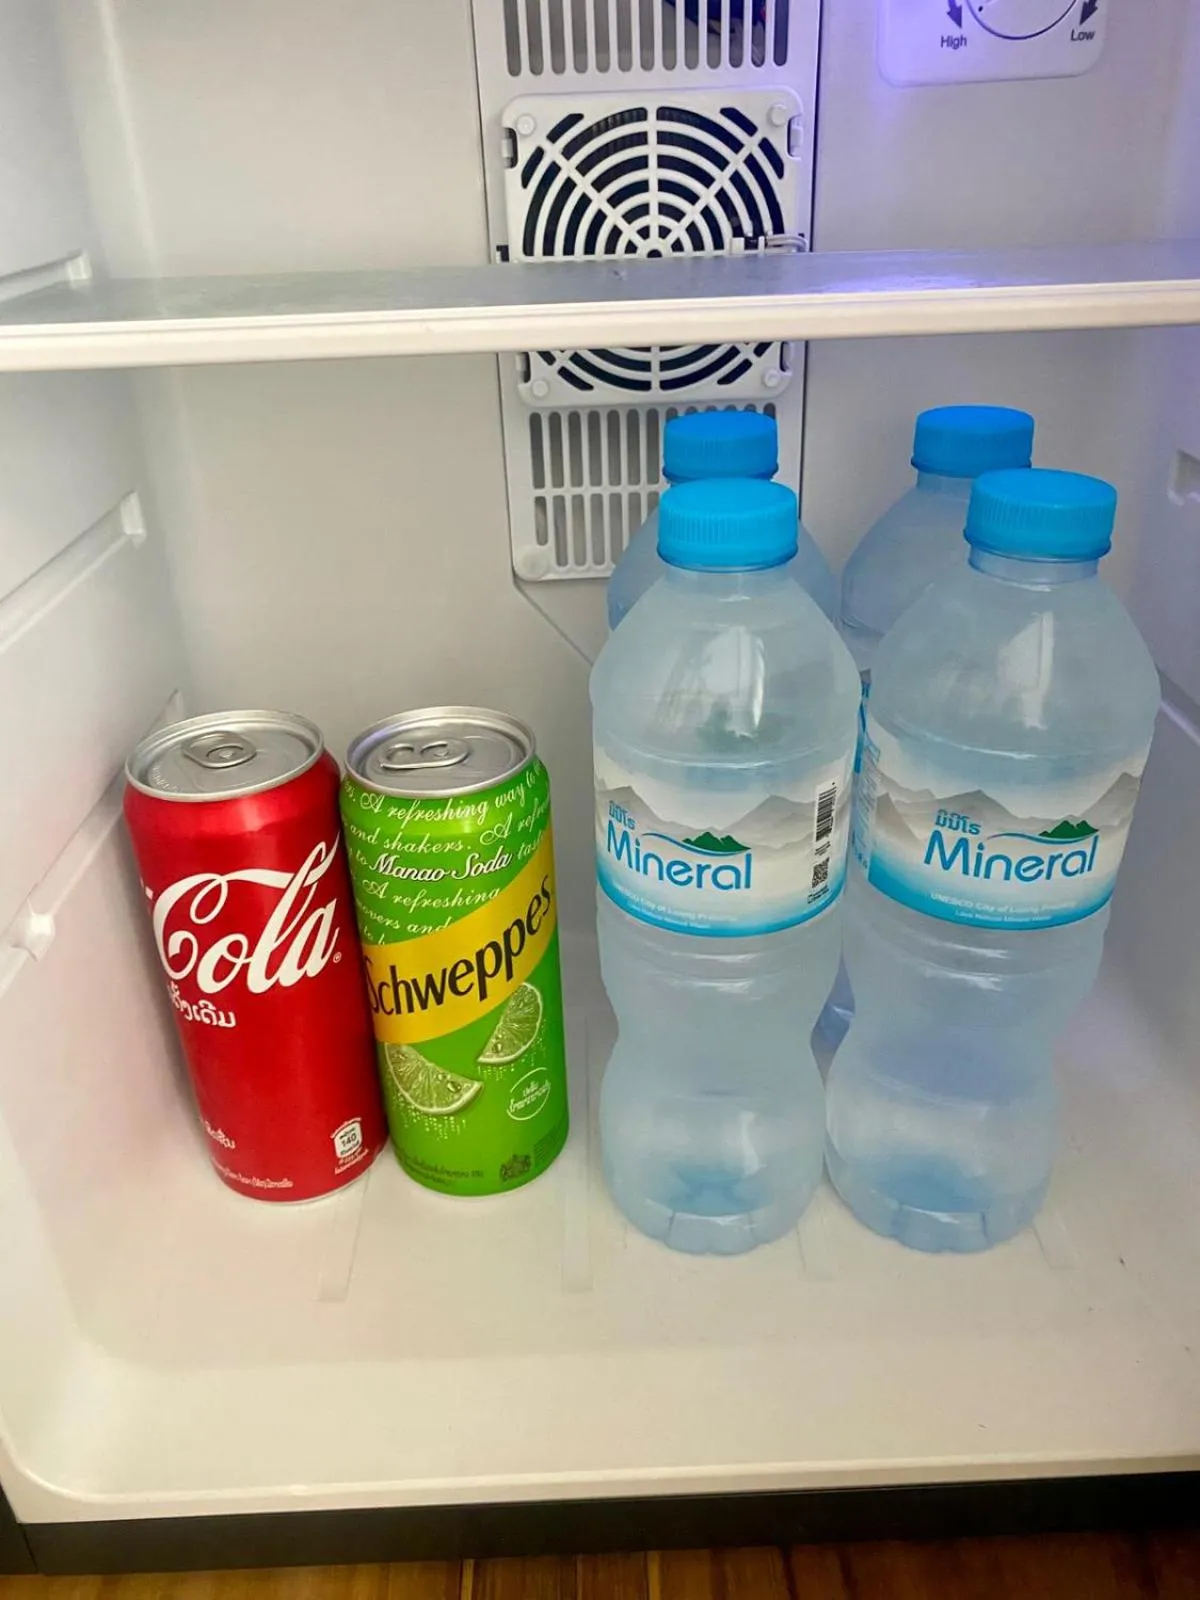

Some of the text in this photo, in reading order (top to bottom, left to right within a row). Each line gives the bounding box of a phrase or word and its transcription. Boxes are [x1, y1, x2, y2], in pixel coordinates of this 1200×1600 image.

[940, 35, 967, 49] High
[1070, 29, 1096, 42] Low
[360, 792, 386, 813] A
[387, 798, 488, 829] refreshing
[495, 782, 525, 807] way
[350, 826, 380, 845] and
[479, 812, 513, 846] A
[369, 852, 450, 883] Manao
[452, 843, 513, 880] Soda
[607, 820, 752, 891] Mineral
[924, 830, 1099, 883] Mineral
[362, 879, 388, 899] A
[153, 831, 341, 995] Cola
[364, 873, 555, 1016] Schweppes
